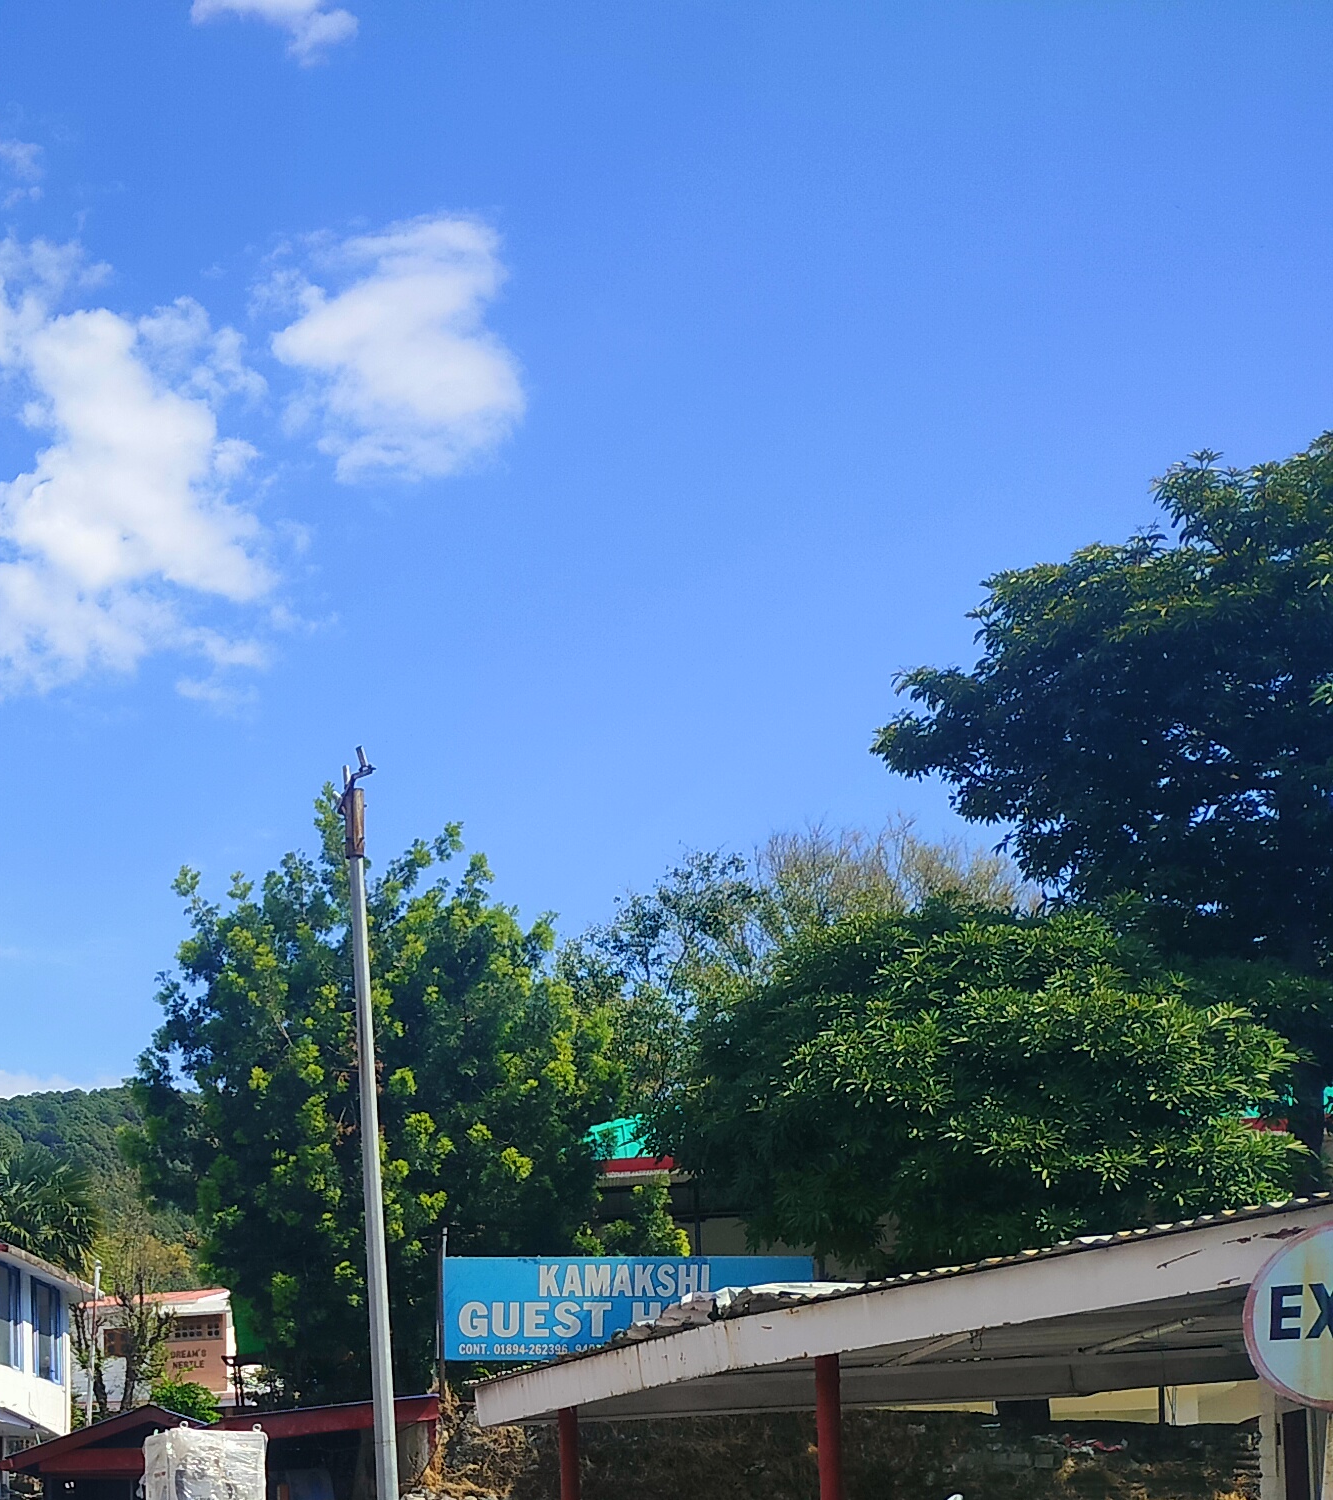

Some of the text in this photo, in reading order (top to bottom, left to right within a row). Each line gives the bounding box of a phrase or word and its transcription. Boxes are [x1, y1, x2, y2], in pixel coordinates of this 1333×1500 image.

[538, 1264, 711, 1299] KAMAKSHI
[458, 1301, 613, 1339] GUEST
[1269, 1283, 1333, 1341] EX
[171, 1349, 207, 1359] DREAM'S
[458, 1344, 490, 1355] CONT.
[494, 1344, 568, 1355] 01894-262396
